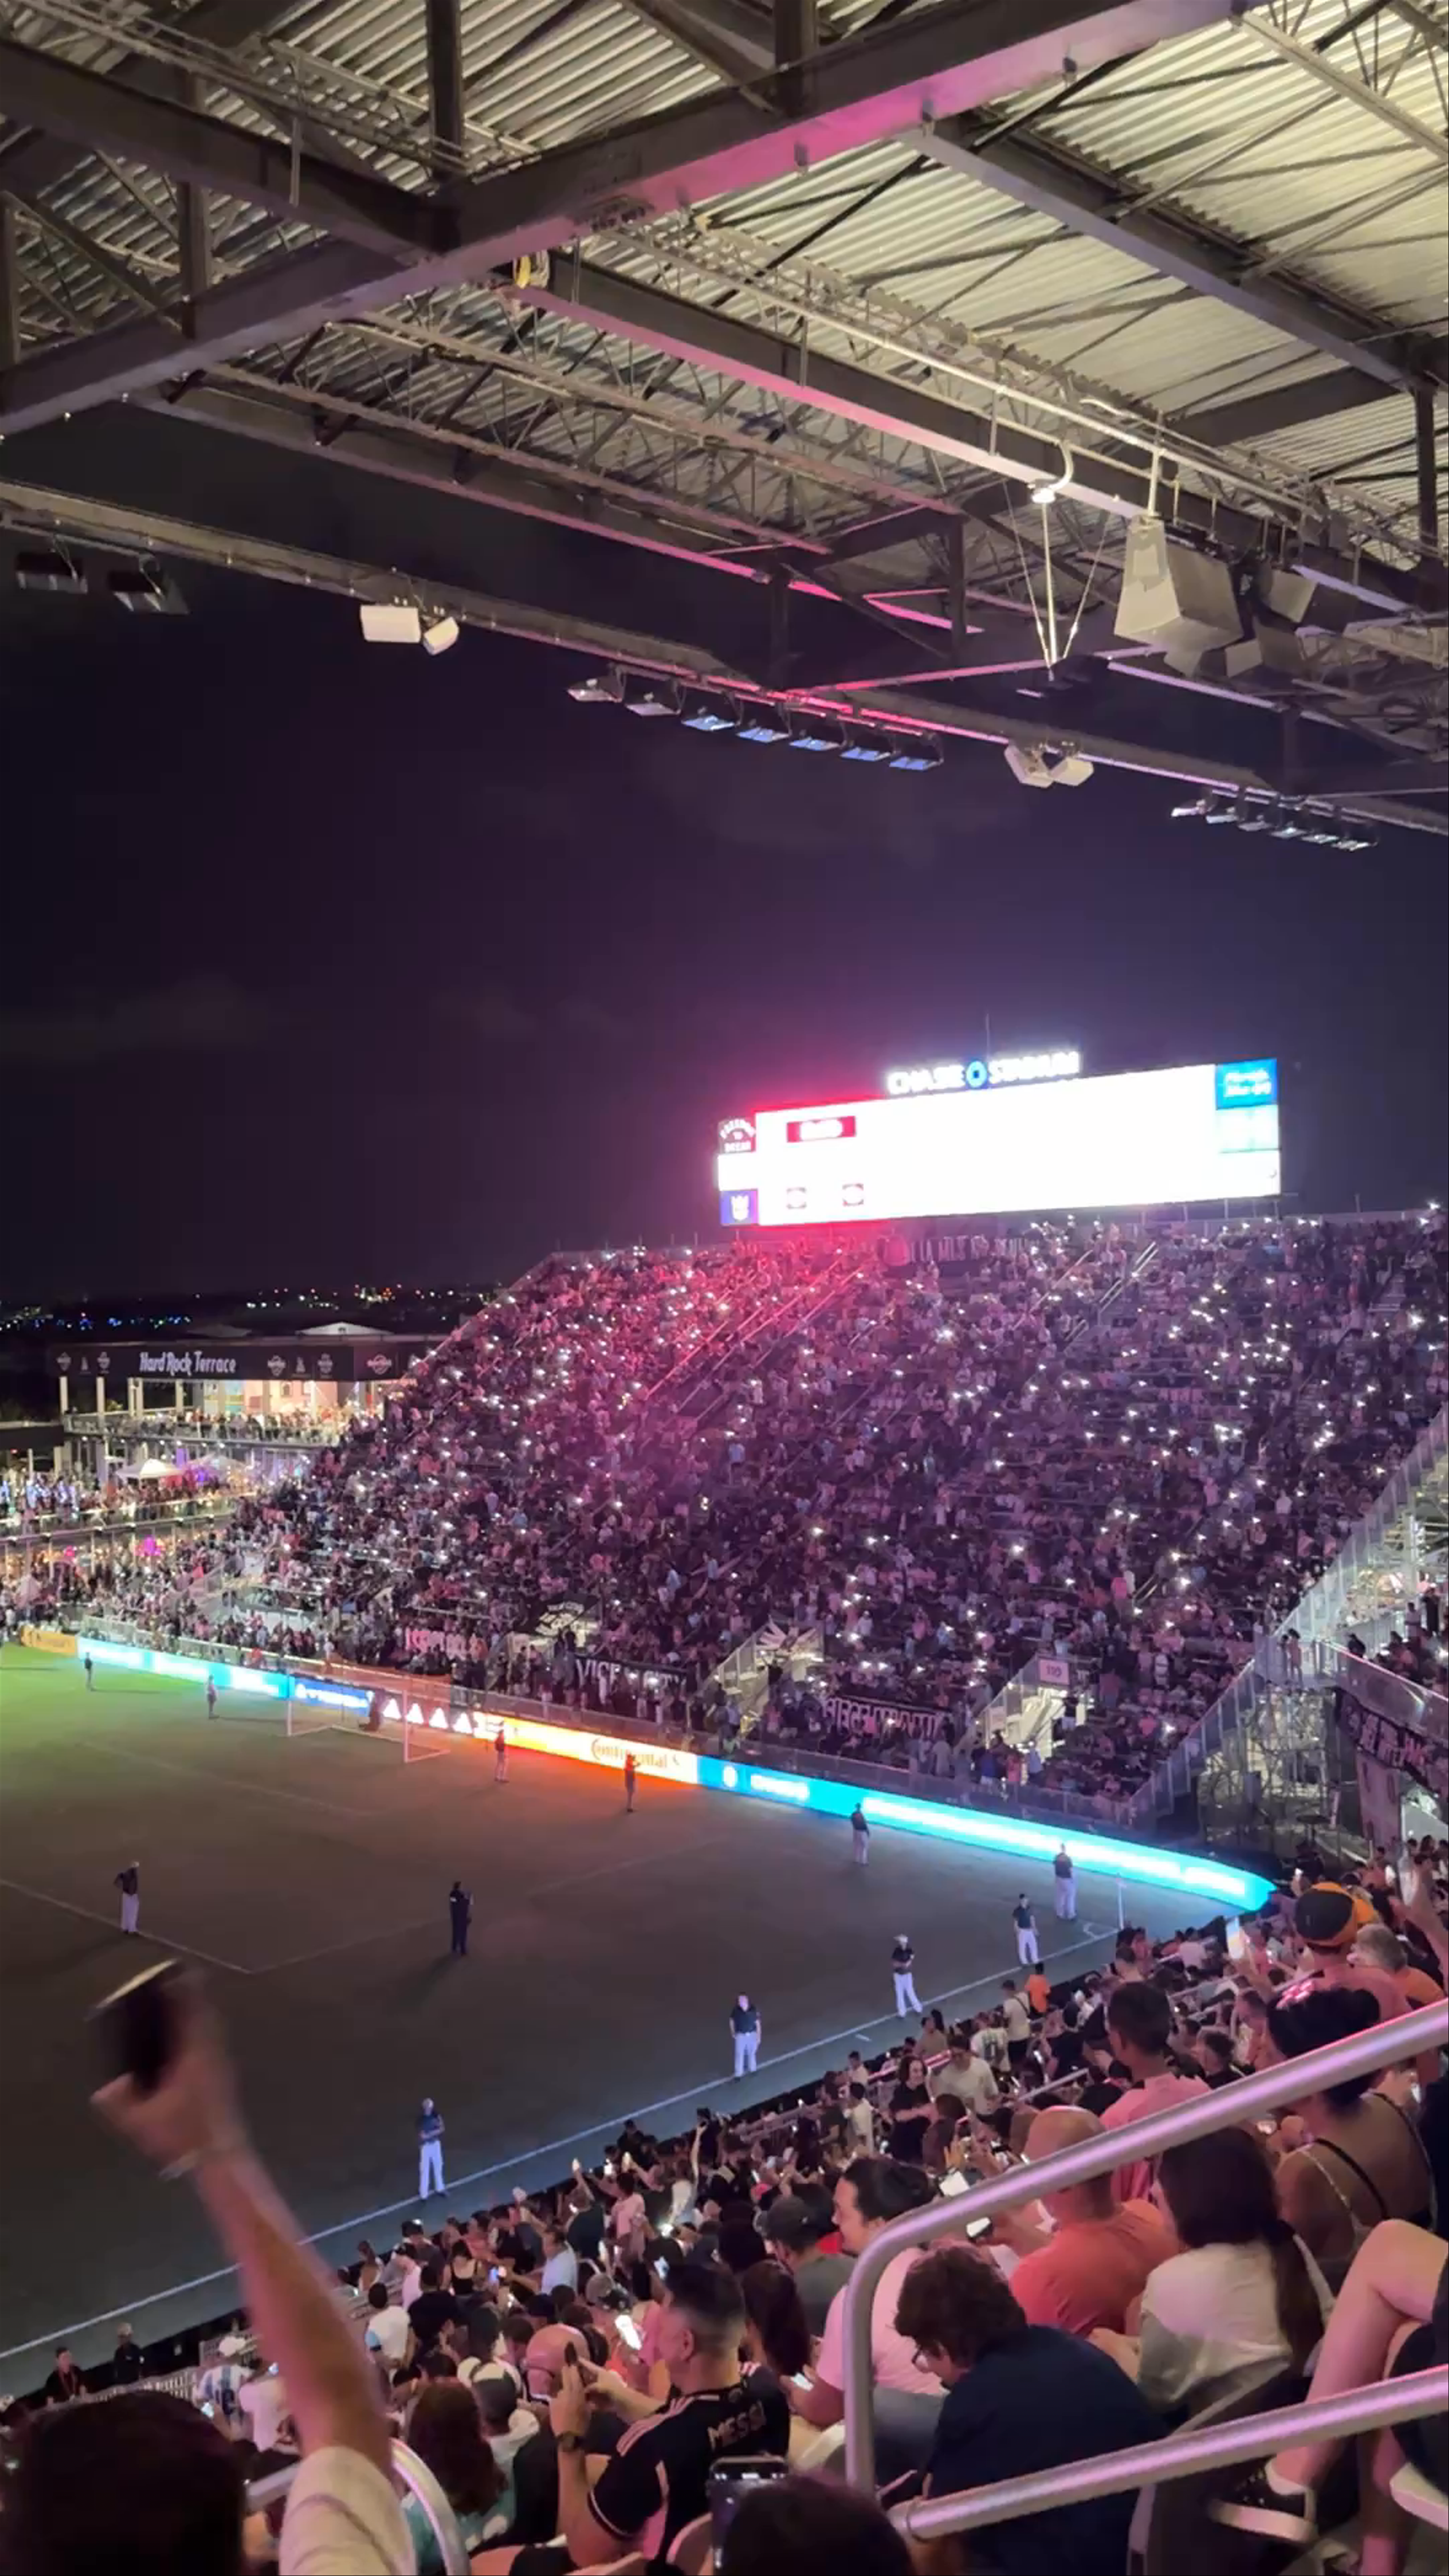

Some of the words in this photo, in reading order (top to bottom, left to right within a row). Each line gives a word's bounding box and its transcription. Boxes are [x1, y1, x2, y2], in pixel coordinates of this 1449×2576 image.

[139, 1351, 165, 1373] Hard
[165, 1351, 192, 1376] Rock
[194, 1350, 236, 1373] Terrace
[591, 1738, 668, 1769] Continntal
